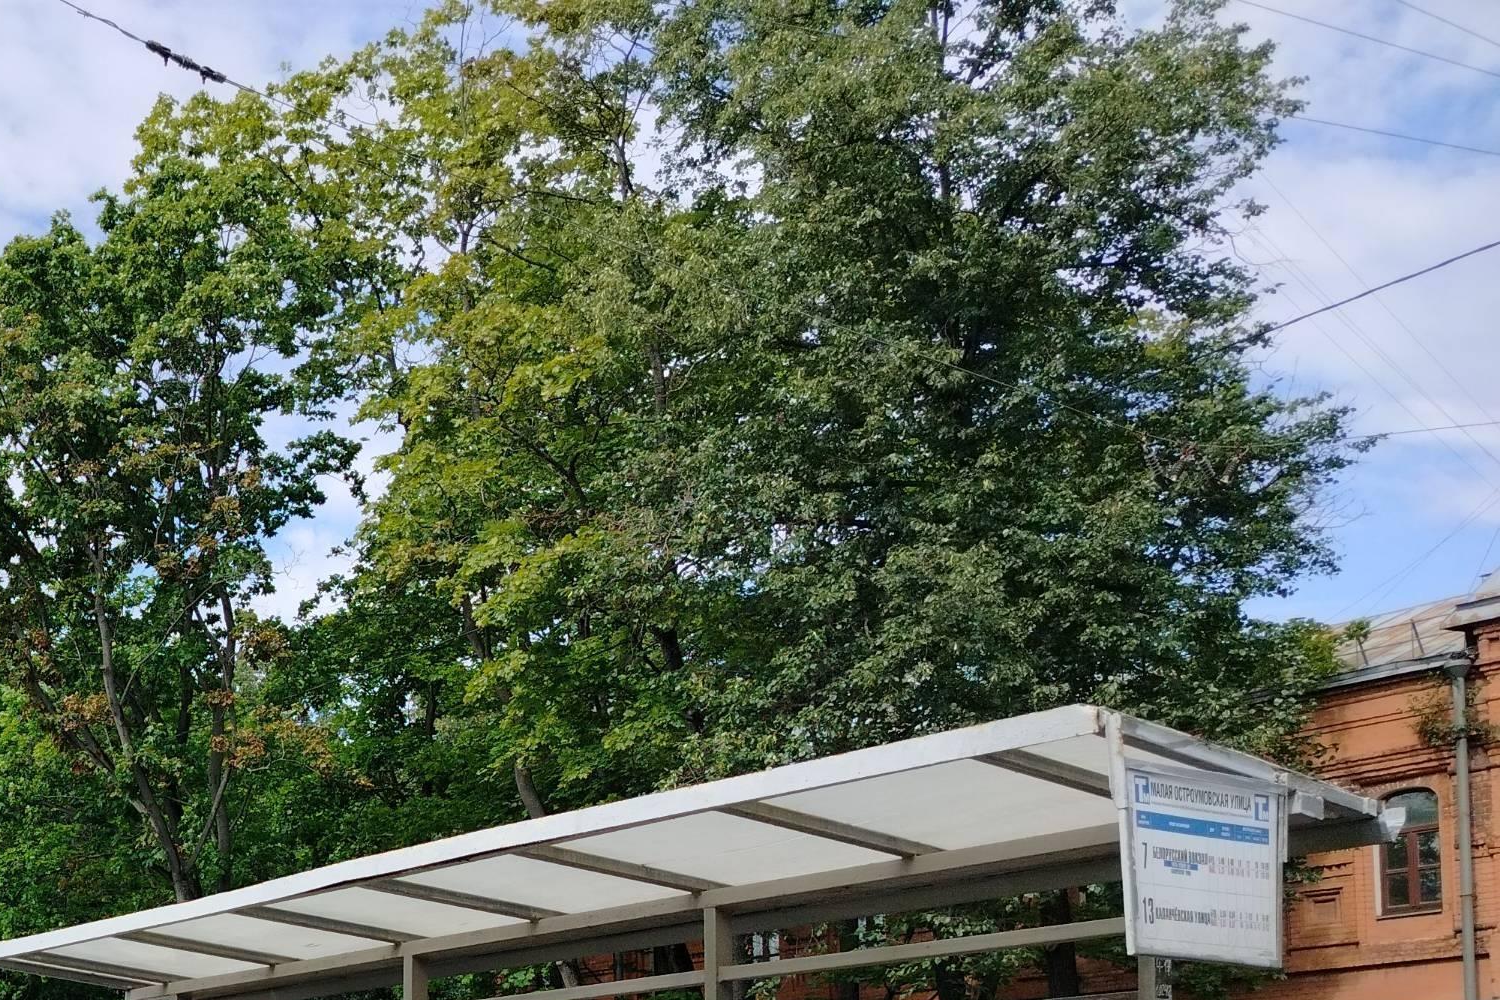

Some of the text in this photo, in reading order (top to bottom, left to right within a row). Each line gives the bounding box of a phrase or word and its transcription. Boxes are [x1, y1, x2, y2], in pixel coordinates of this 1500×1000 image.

[1150, 781, 1252, 812] МАЛАЯ ОСТРОУМОВСКАЯ УЛИЦА
[1142, 841, 1147, 869] 7
[1142, 897, 1154, 924] 13
